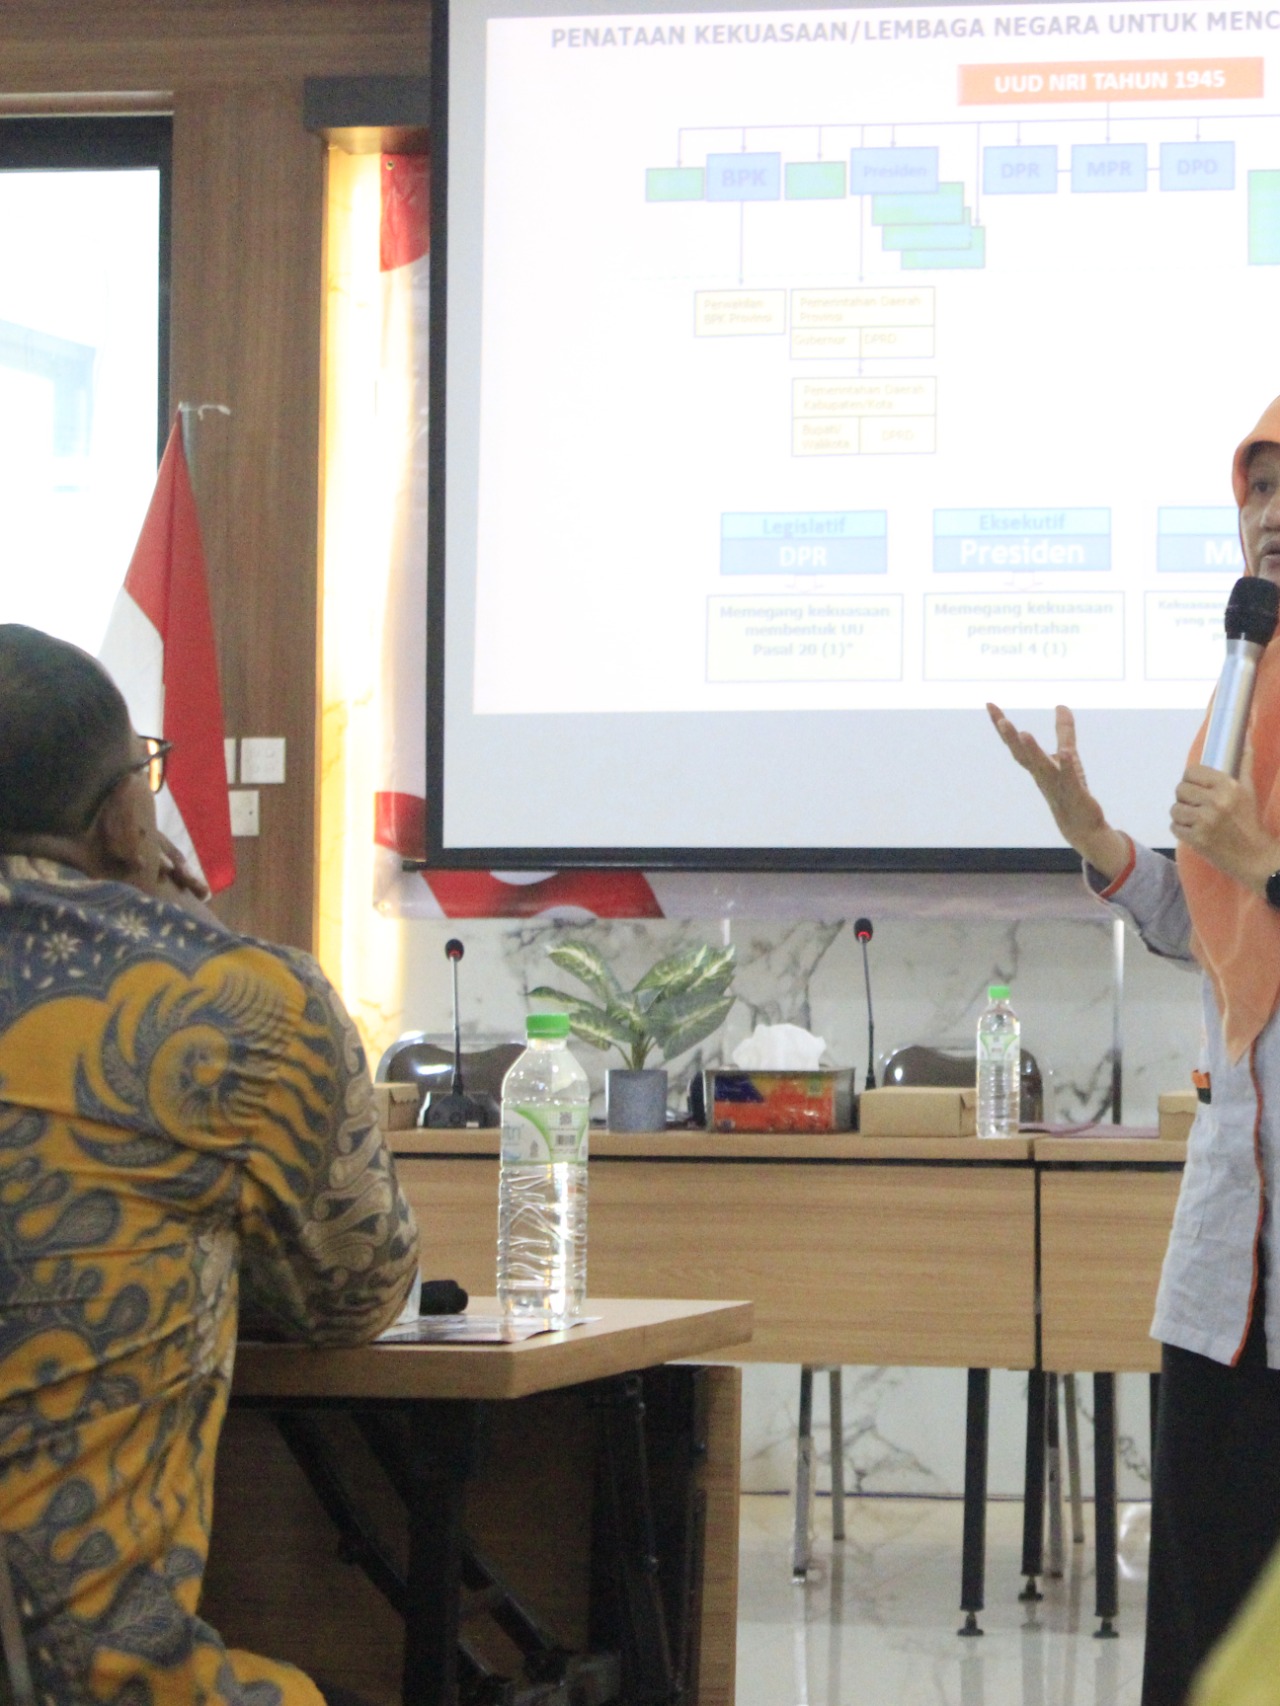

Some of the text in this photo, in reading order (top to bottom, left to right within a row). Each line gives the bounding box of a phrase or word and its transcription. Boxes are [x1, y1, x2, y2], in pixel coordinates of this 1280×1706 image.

[551, 26, 685, 48] PENATAAN
[695, 18, 985, 45] KEKUASAAN/LEMBAGA
[994, 14, 1099, 36] NEGARA
[1109, 12, 1197, 34] UNTUK
[994, 70, 1226, 93] UUD NRI TAHUN 1945
[722, 168, 767, 187] BPK
[863, 164, 927, 178] Presiden
[1001, 162, 1040, 179] DPR
[1087, 160, 1132, 178] MPR
[763, 517, 847, 539] Legislatif
[979, 514, 1066, 531] Eksekutif
[780, 547, 828, 567] DPR
[960, 538, 1085, 565] Presiden
[720, 604, 890, 622] Memegang kekuasaan
[934, 600, 1113, 618] Memegang kekuasaan
[746, 624, 836, 636] membentuk
[967, 621, 1081, 638] pemerintahan
[753, 643, 793, 656] Pasal
[981, 641, 1067, 658] Pasal 4 (1)
